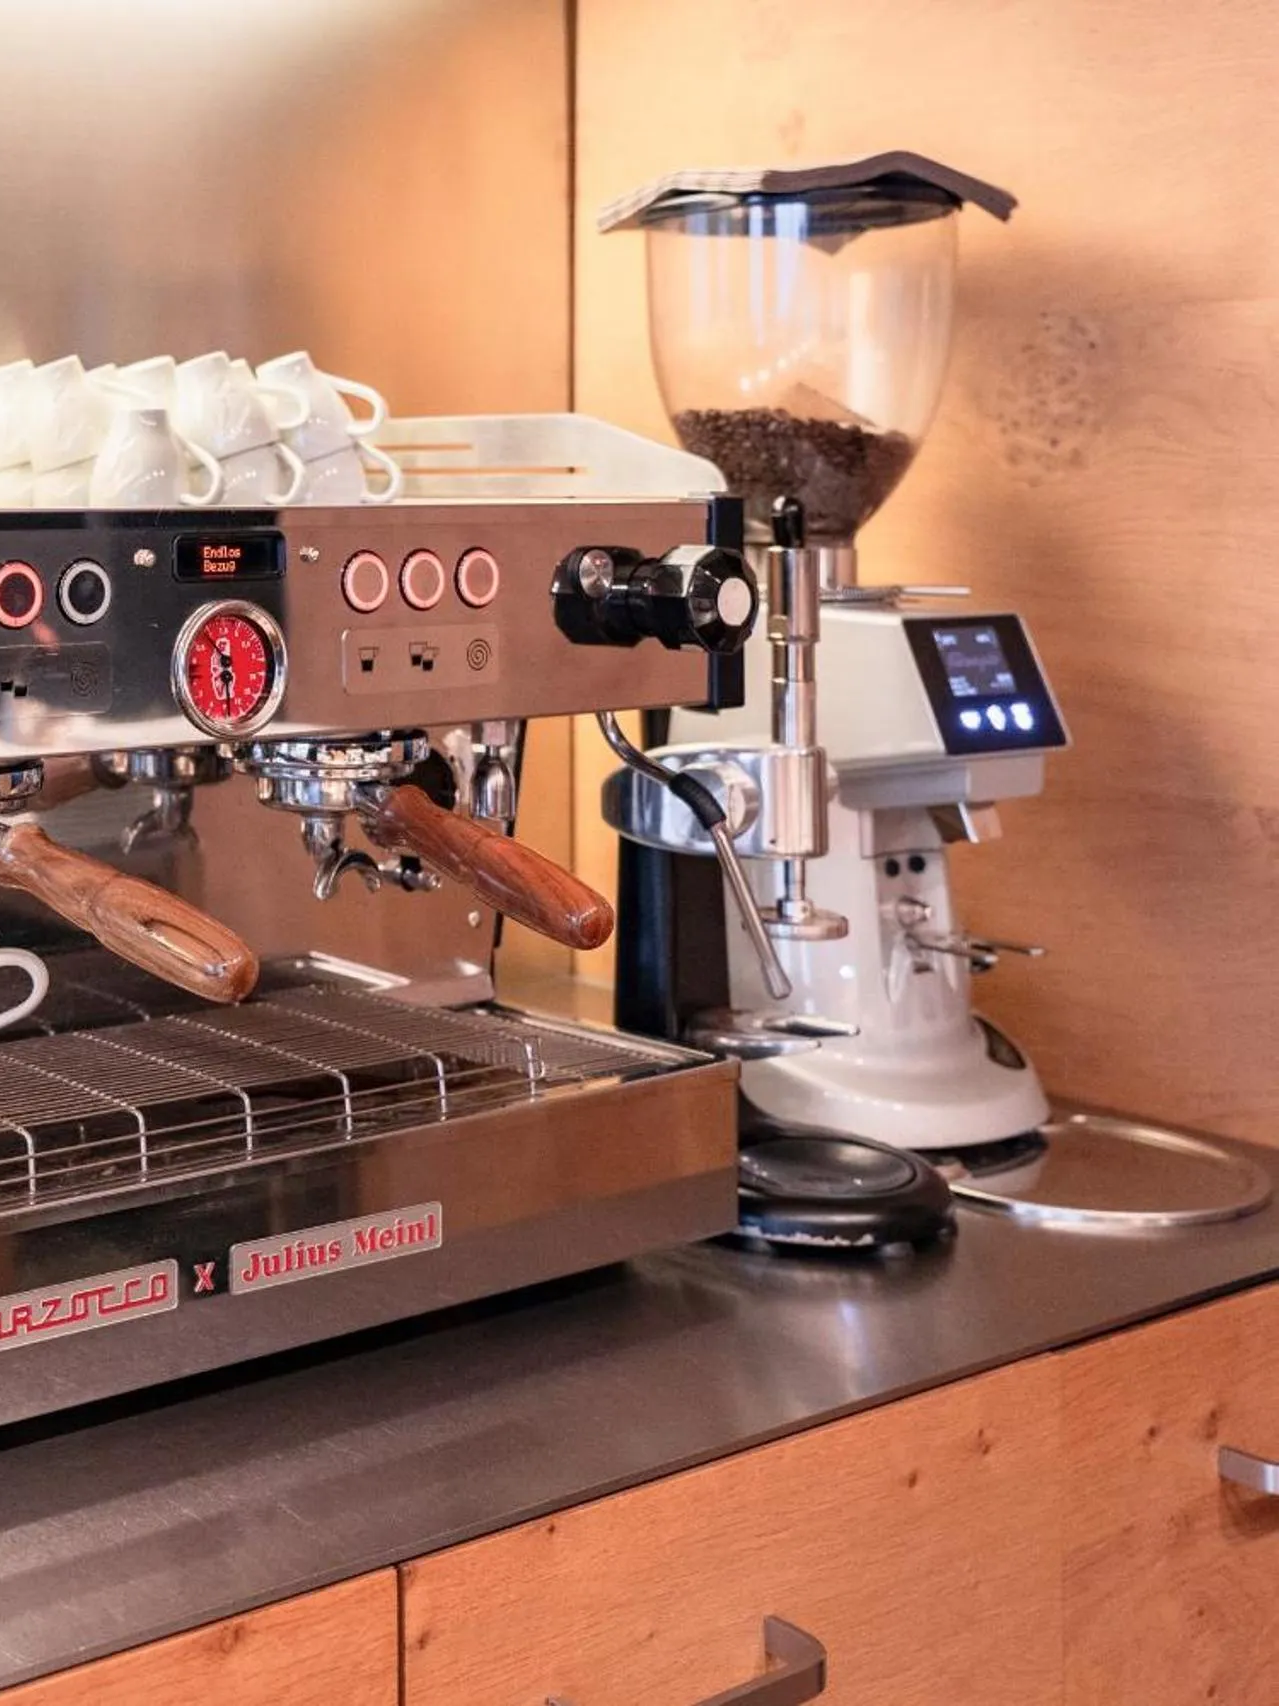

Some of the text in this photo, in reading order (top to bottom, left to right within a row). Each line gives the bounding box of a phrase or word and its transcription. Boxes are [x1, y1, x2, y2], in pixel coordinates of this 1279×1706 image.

[204, 546, 241, 559] Endlos
[204, 560, 236, 572] Bezug
[241, 1240, 343, 1282] Julius
[352, 1214, 437, 1257] Meinl
